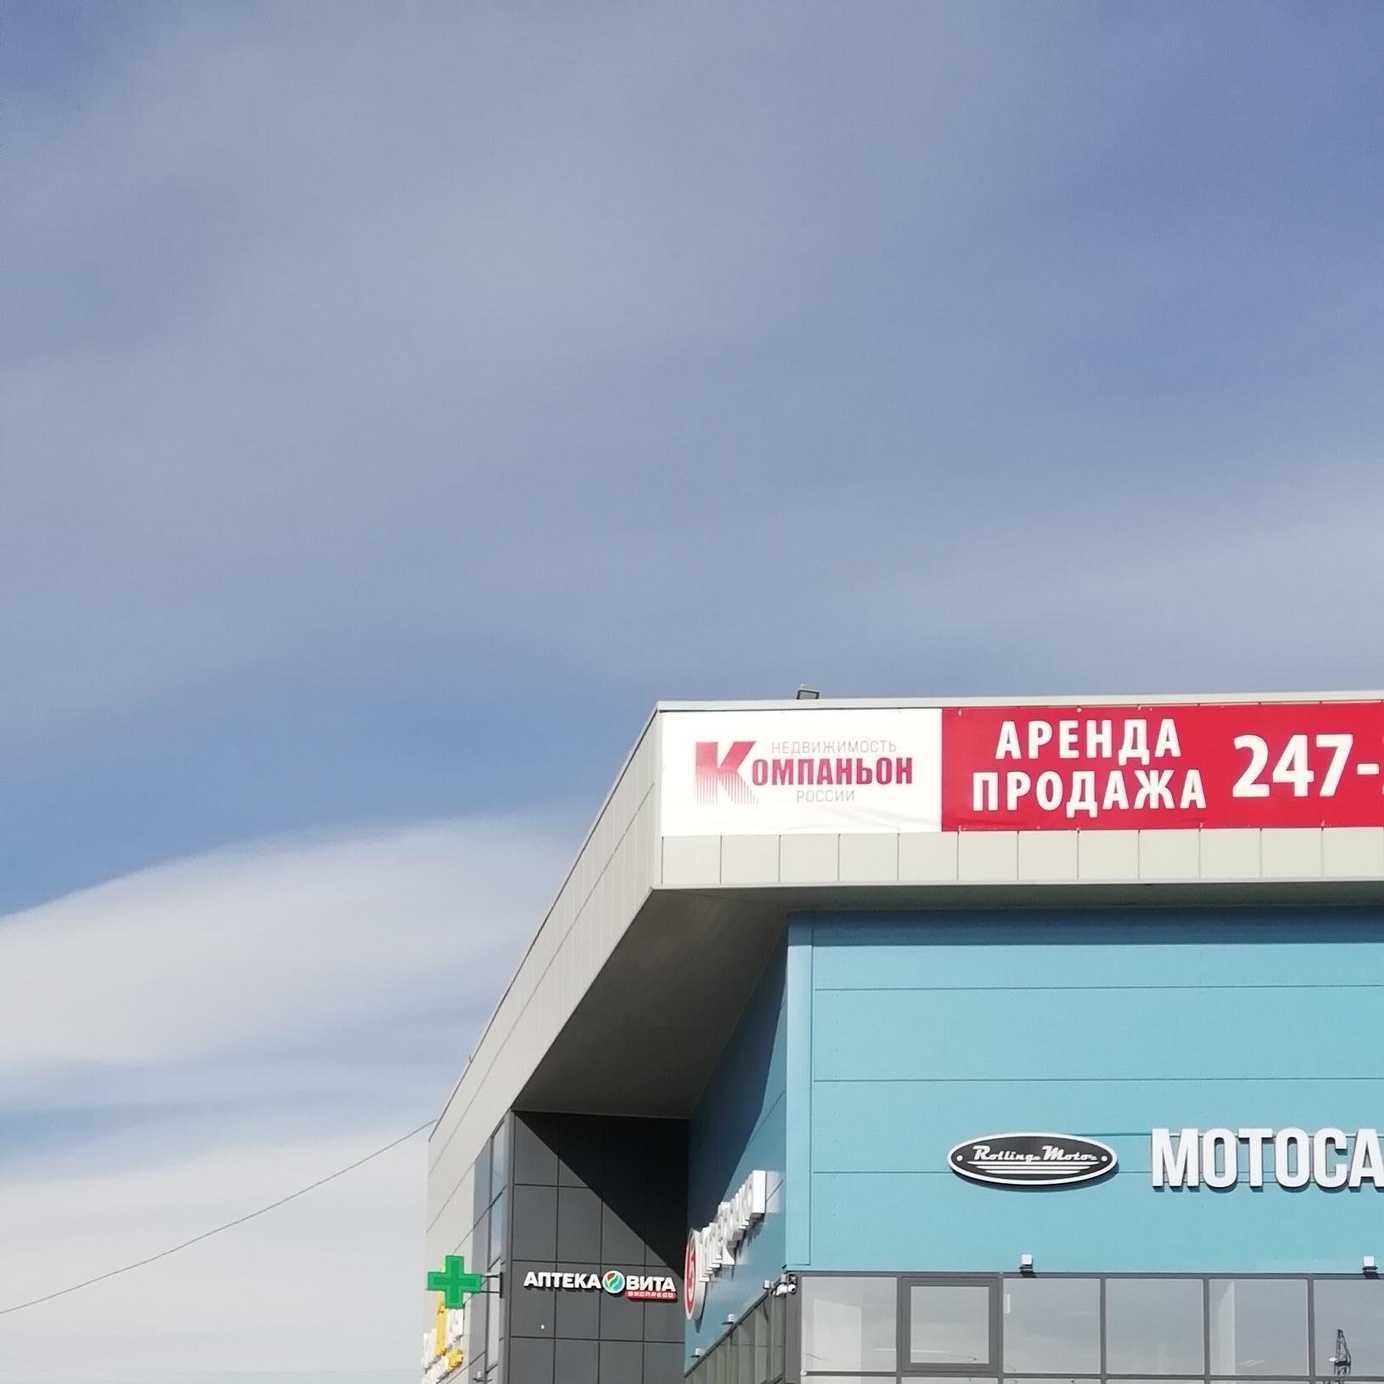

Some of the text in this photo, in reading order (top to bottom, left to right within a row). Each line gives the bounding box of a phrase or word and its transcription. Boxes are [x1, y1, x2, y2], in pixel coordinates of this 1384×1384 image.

[770, 739, 897, 755] НЕДВИЖИМОСТЬ
[995, 718, 1182, 766] АРЕНДА
[796, 789, 856, 803] РОССИИ
[972, 769, 1207, 818] ПРОДАЖА
[972, 1145, 1040, 1163] Rolling
[523, 1271, 676, 1292] АПТЕКА ВИТА
